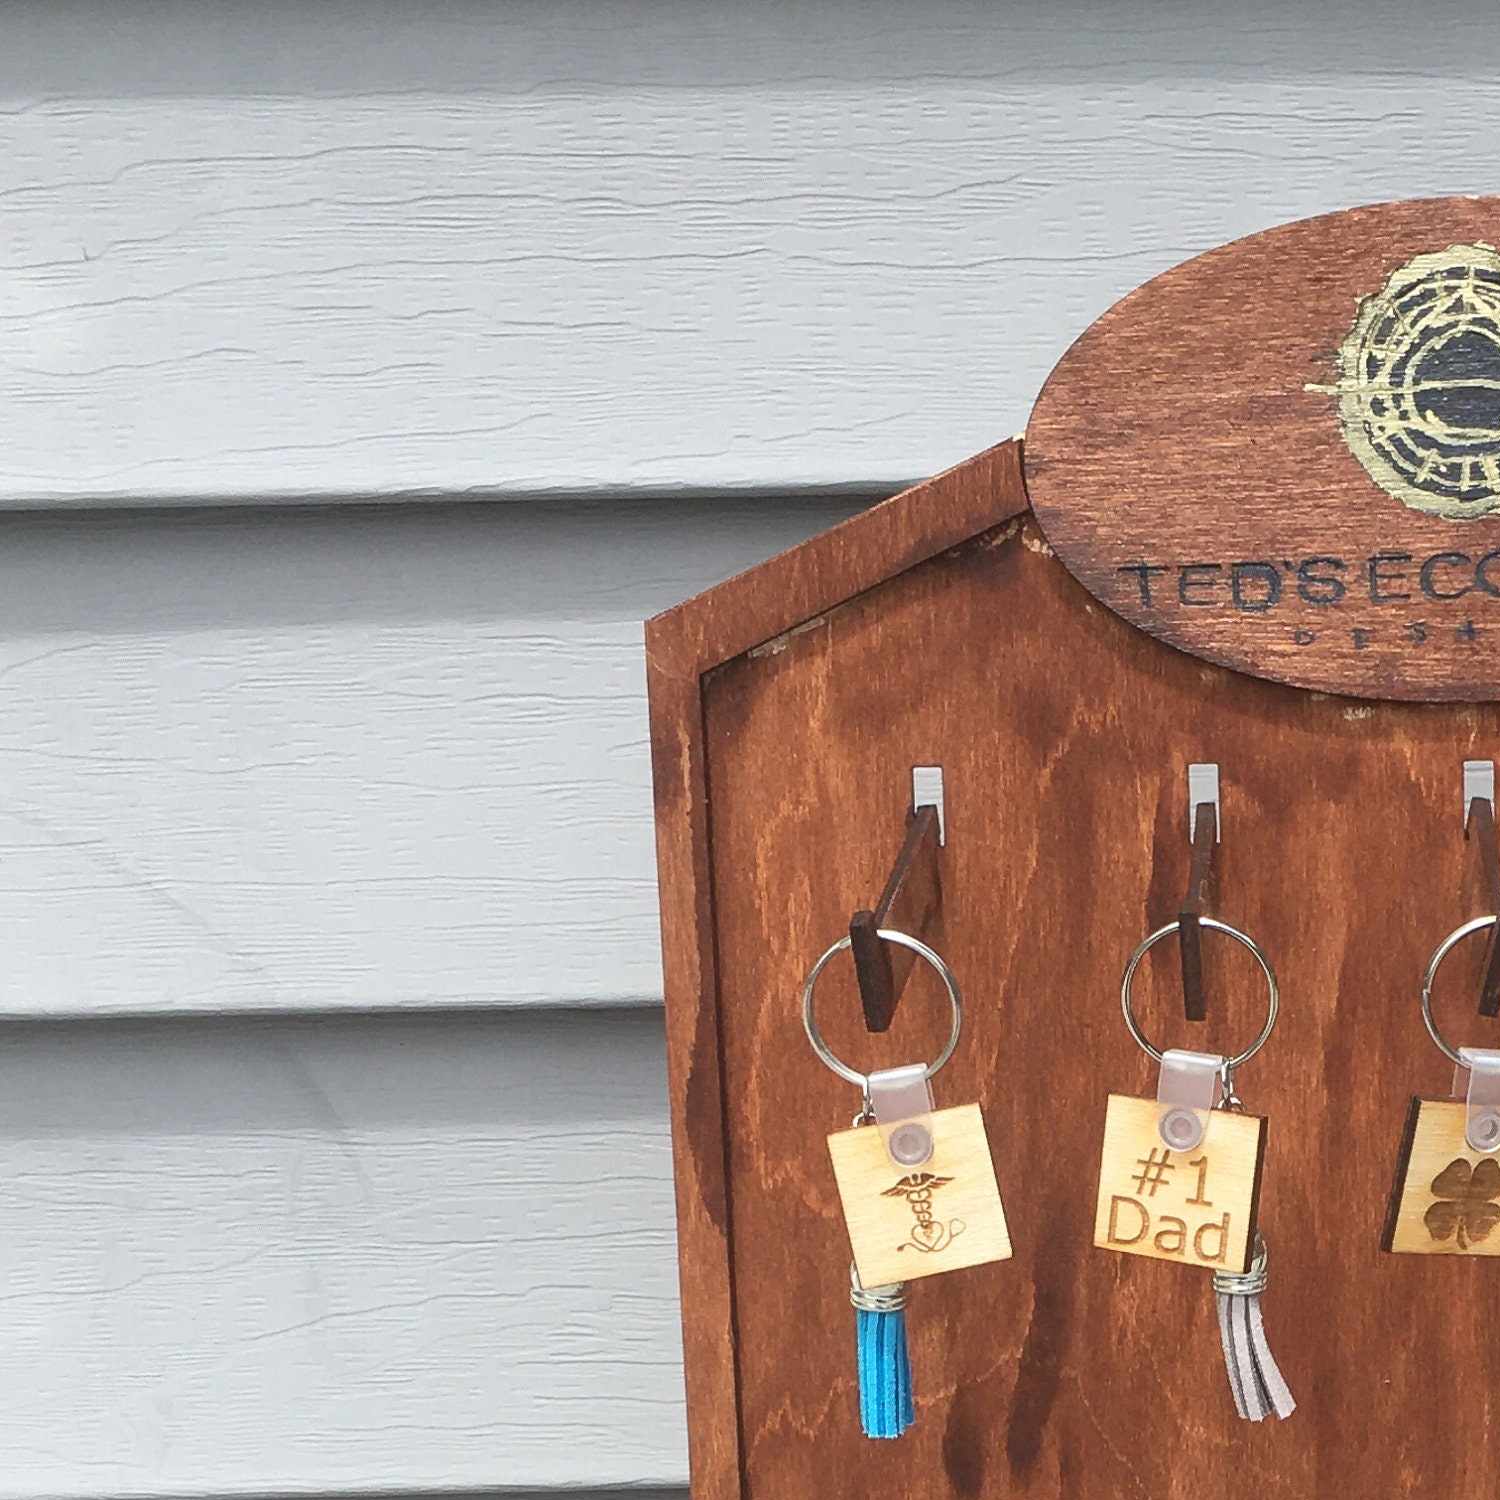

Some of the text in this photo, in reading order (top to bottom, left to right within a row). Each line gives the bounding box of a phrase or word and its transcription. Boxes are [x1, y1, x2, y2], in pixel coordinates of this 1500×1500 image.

[1117, 556, 1348, 613] TED'S
[1132, 1147, 1213, 1207] #1
[1107, 1194, 1231, 1264] Dad
